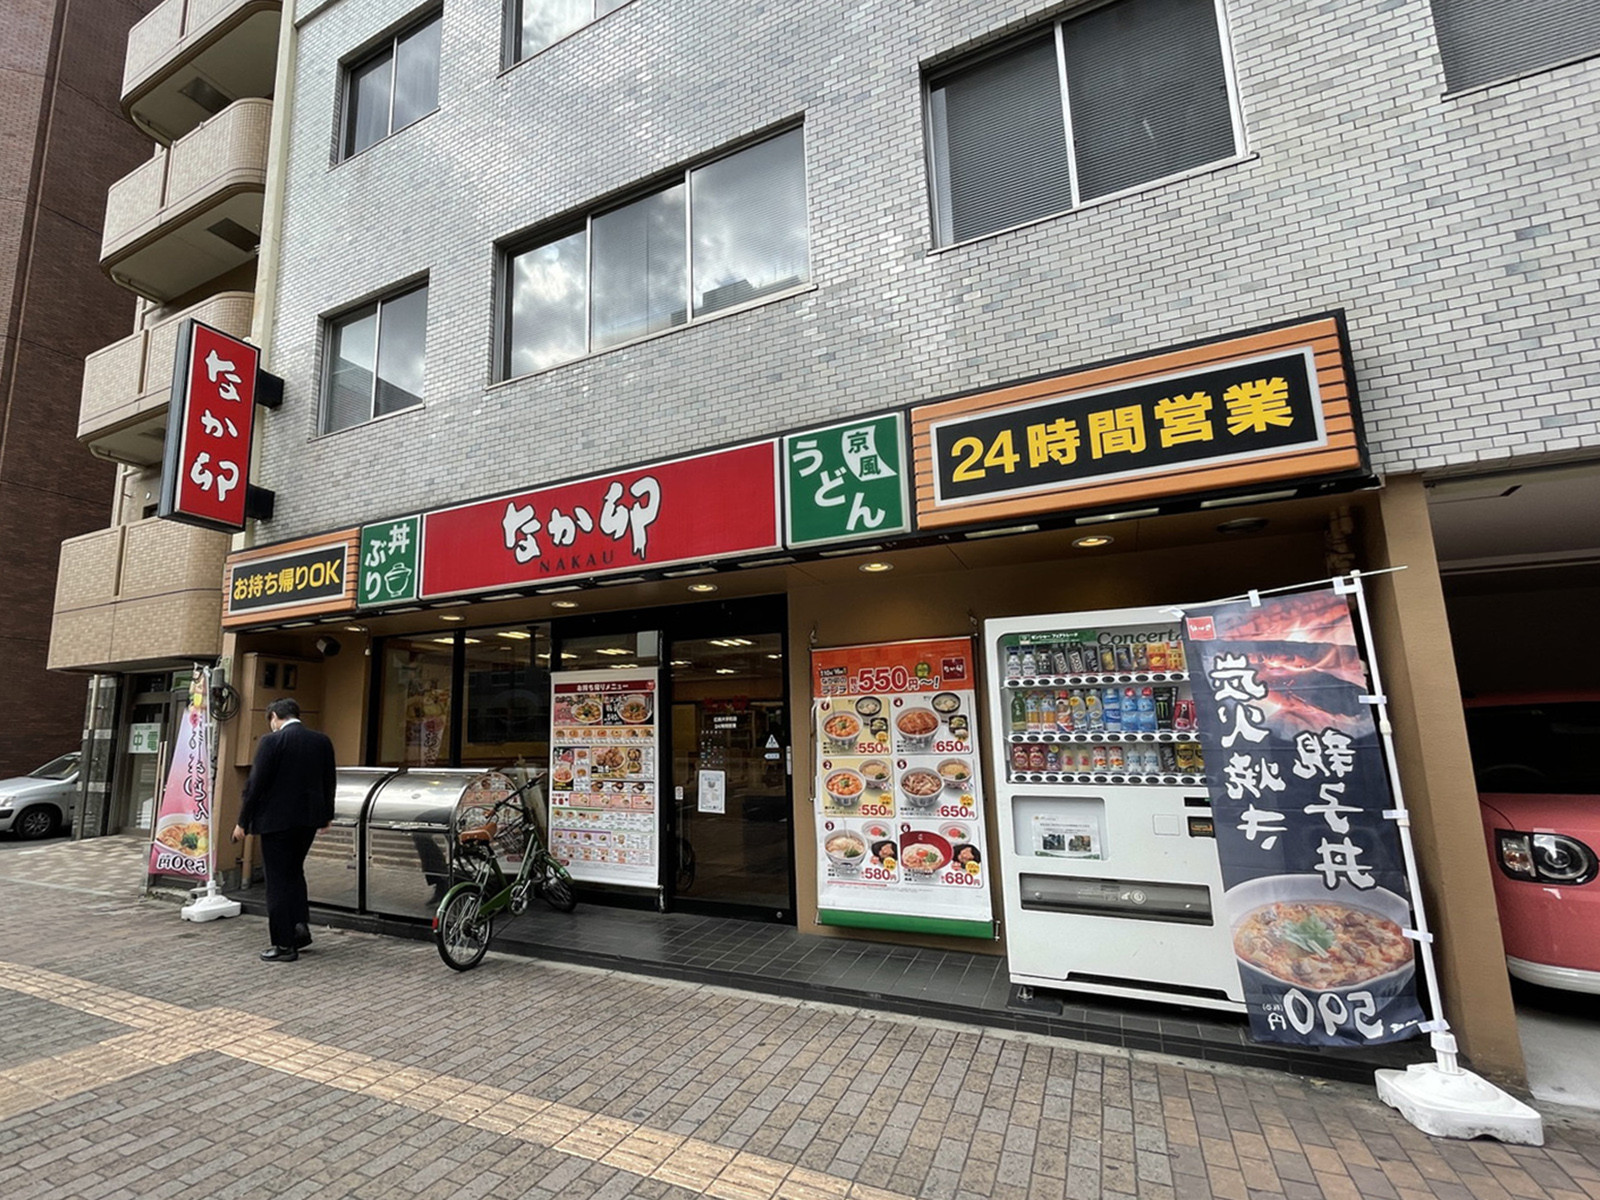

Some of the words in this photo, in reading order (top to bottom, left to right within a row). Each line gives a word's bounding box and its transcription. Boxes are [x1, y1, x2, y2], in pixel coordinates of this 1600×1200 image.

[190, 349, 243, 502] なか卯
[847, 428, 882, 478] 京風
[950, 376, 1294, 483] 24時間営業
[501, 476, 662, 565] なか卯
[792, 439, 886, 533] うどん
[233, 555, 341, 601] お持ち帰りOK
[539, 549, 614, 574] NAKAU
